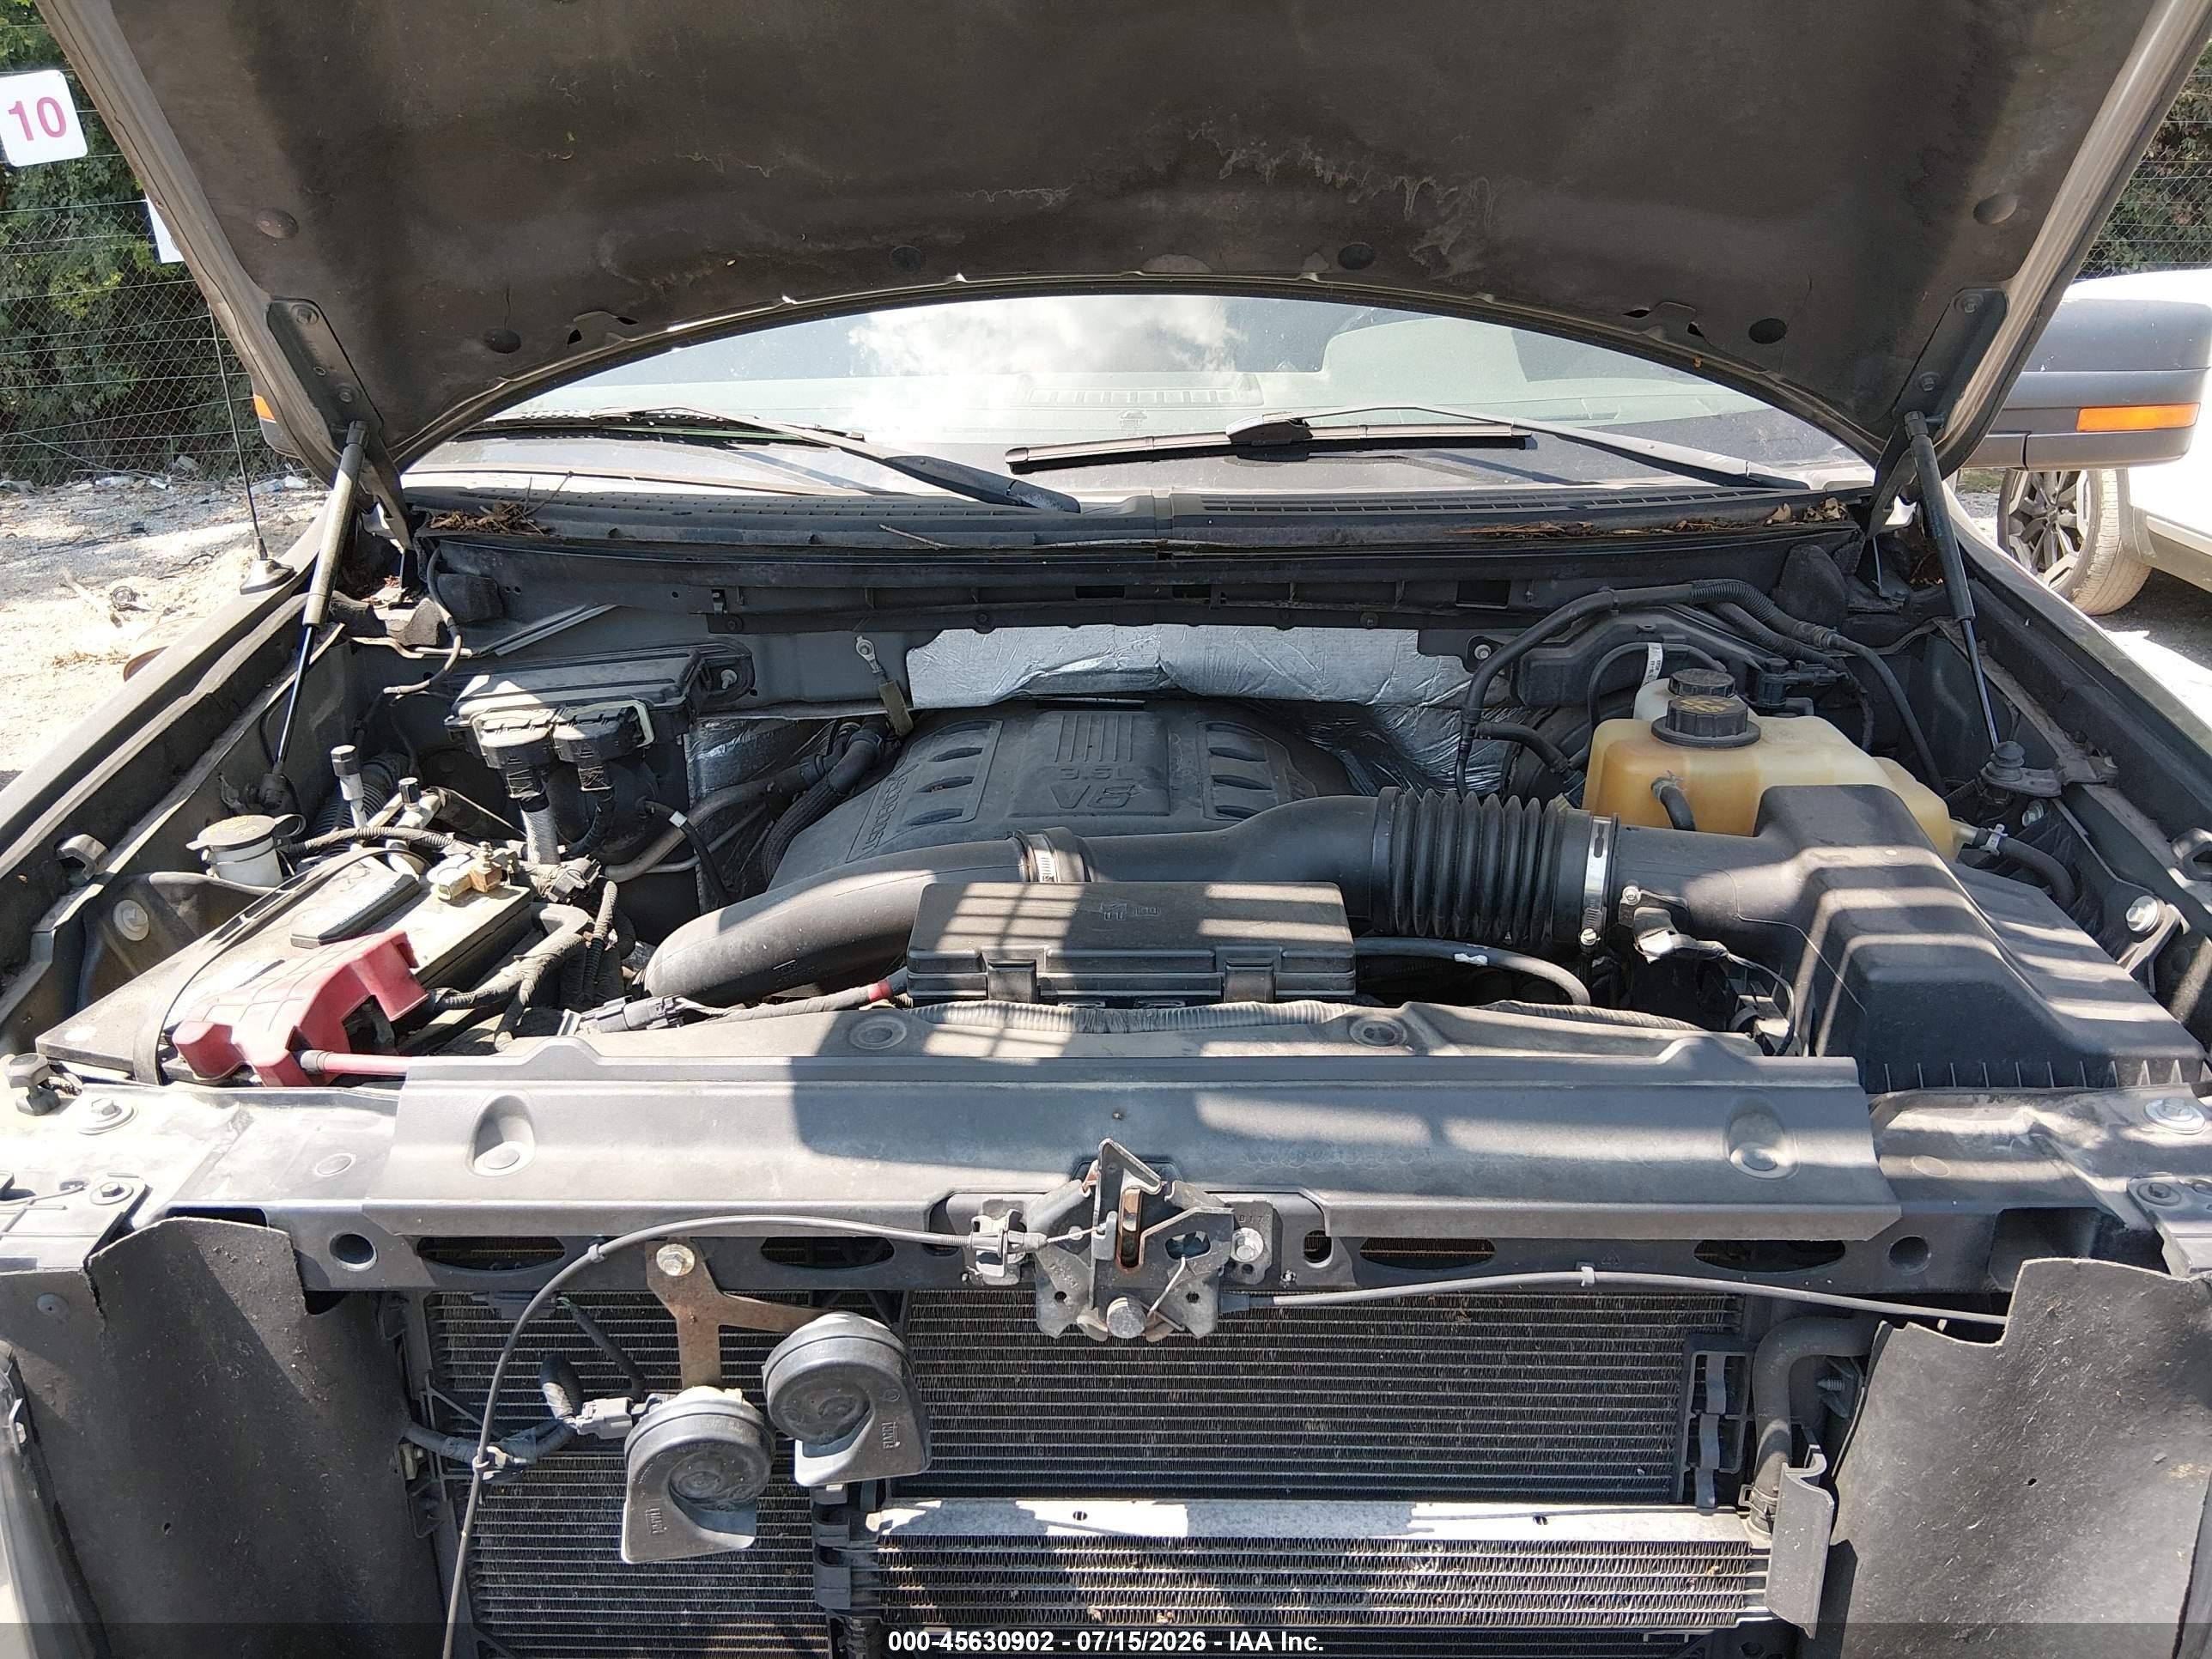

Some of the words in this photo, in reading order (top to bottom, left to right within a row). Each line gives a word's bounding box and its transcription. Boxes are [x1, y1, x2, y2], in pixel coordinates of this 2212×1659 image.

[8, 96, 67, 142] 10
[1059, 766, 1135, 781] 3.5L
[1049, 783, 1136, 810] V6
